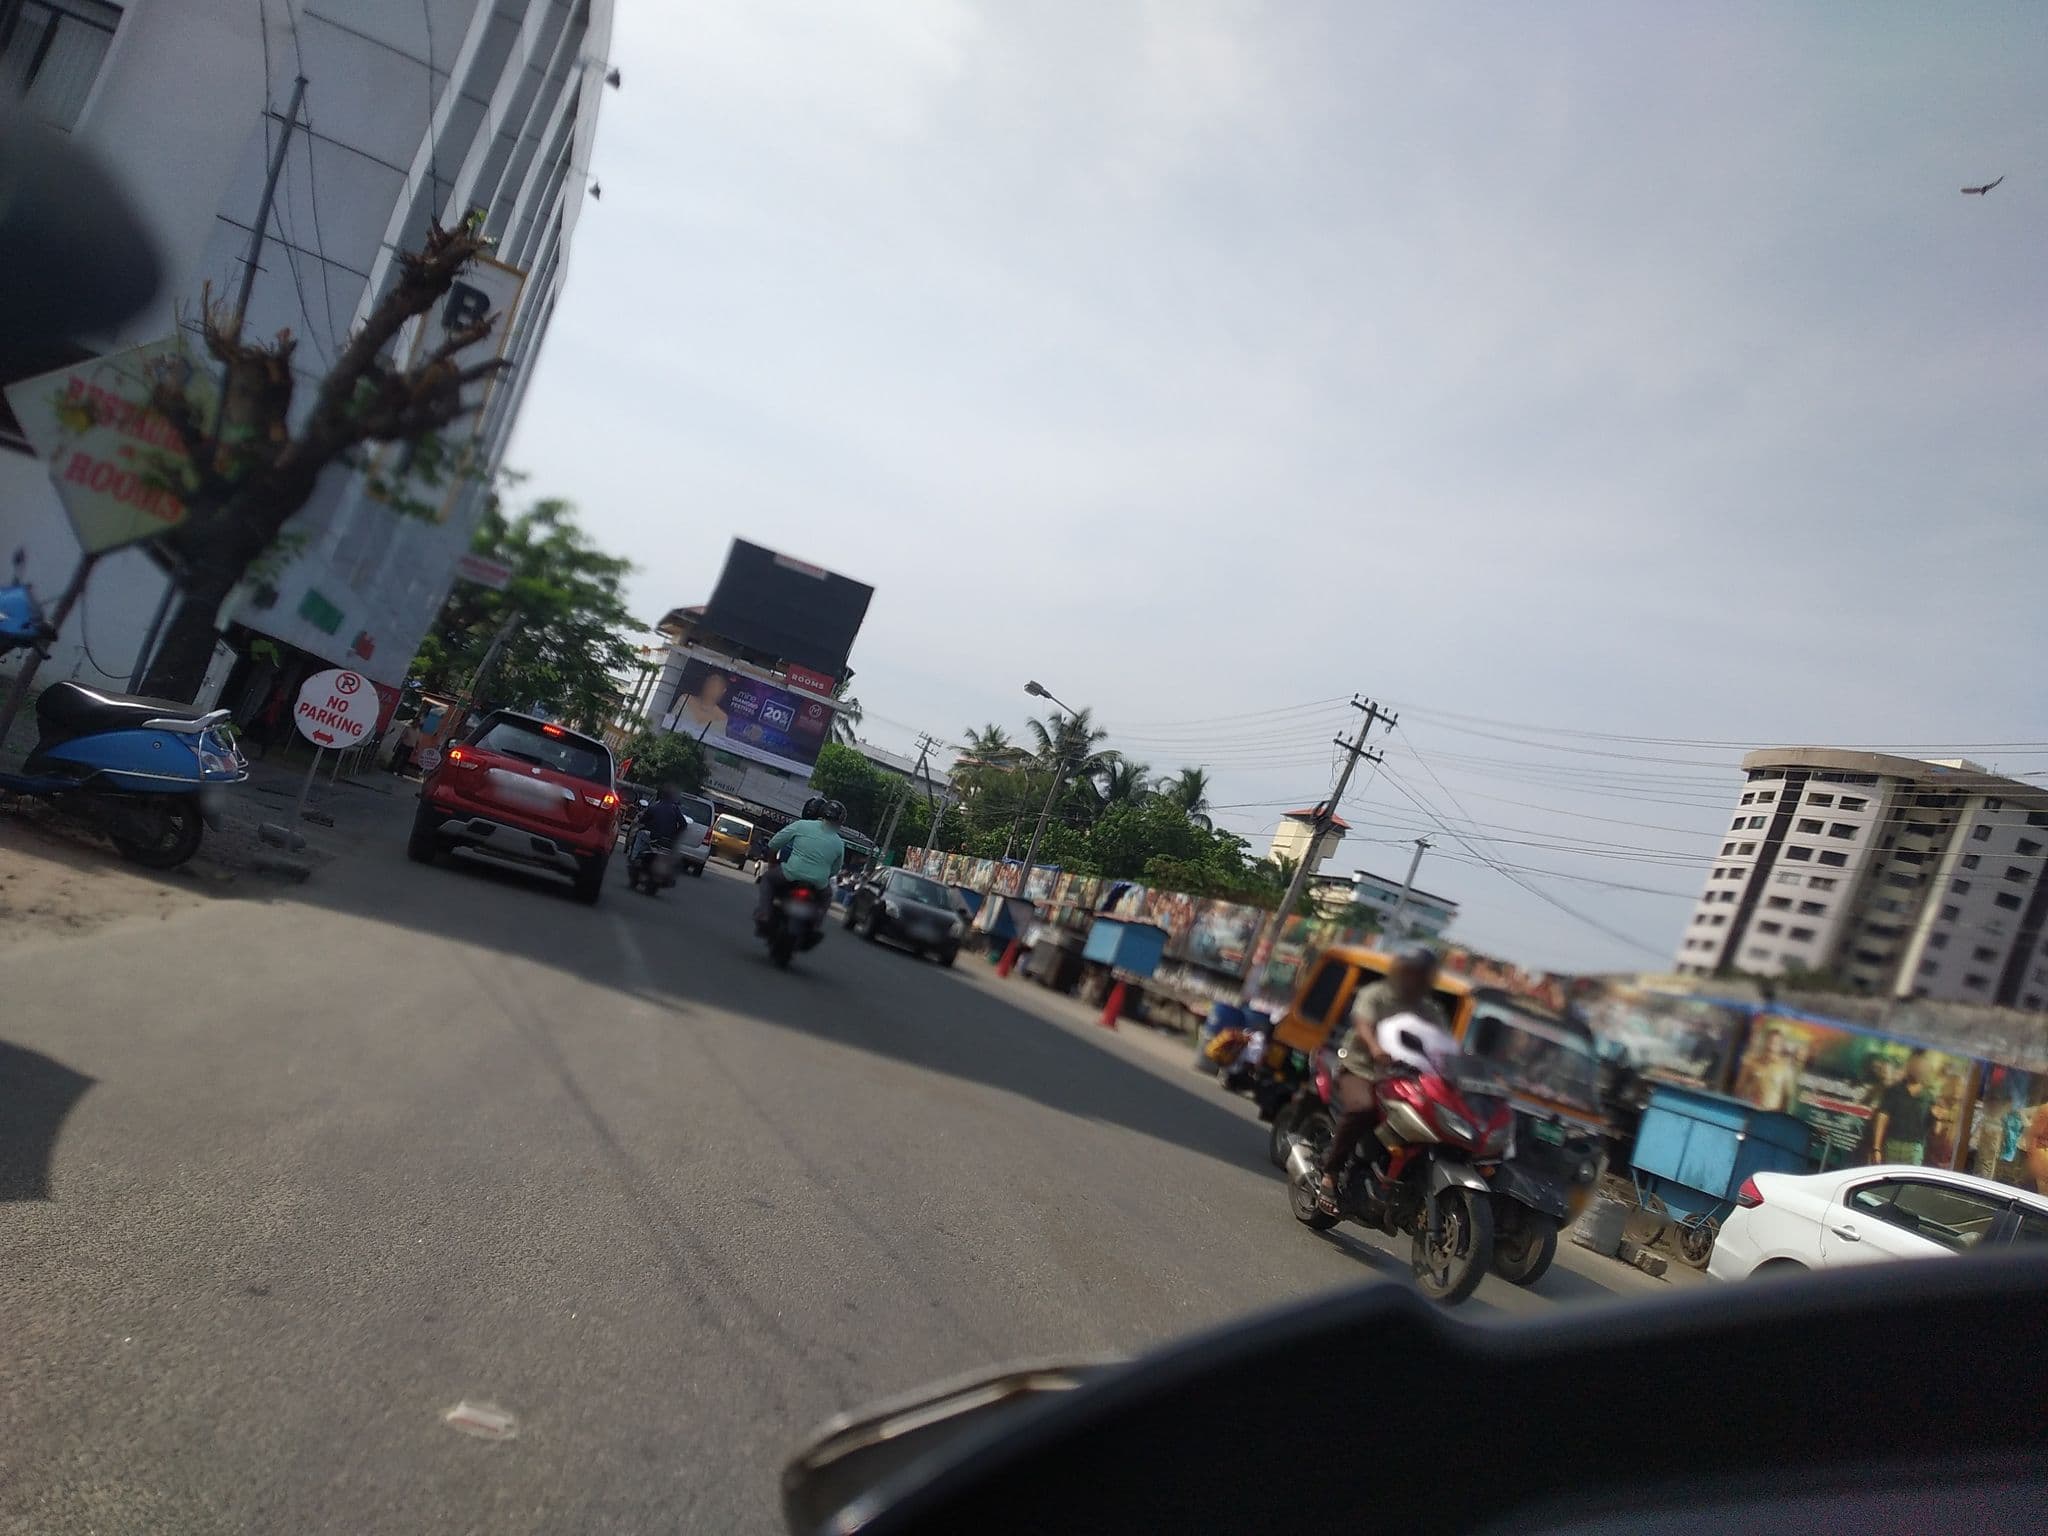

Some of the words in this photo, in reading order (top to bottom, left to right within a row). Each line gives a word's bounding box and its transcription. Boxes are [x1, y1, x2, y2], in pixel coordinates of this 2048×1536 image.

[791, 673, 825, 690] ROOMS
[326, 695, 349, 713] NO
[298, 701, 363, 737] PARKING
